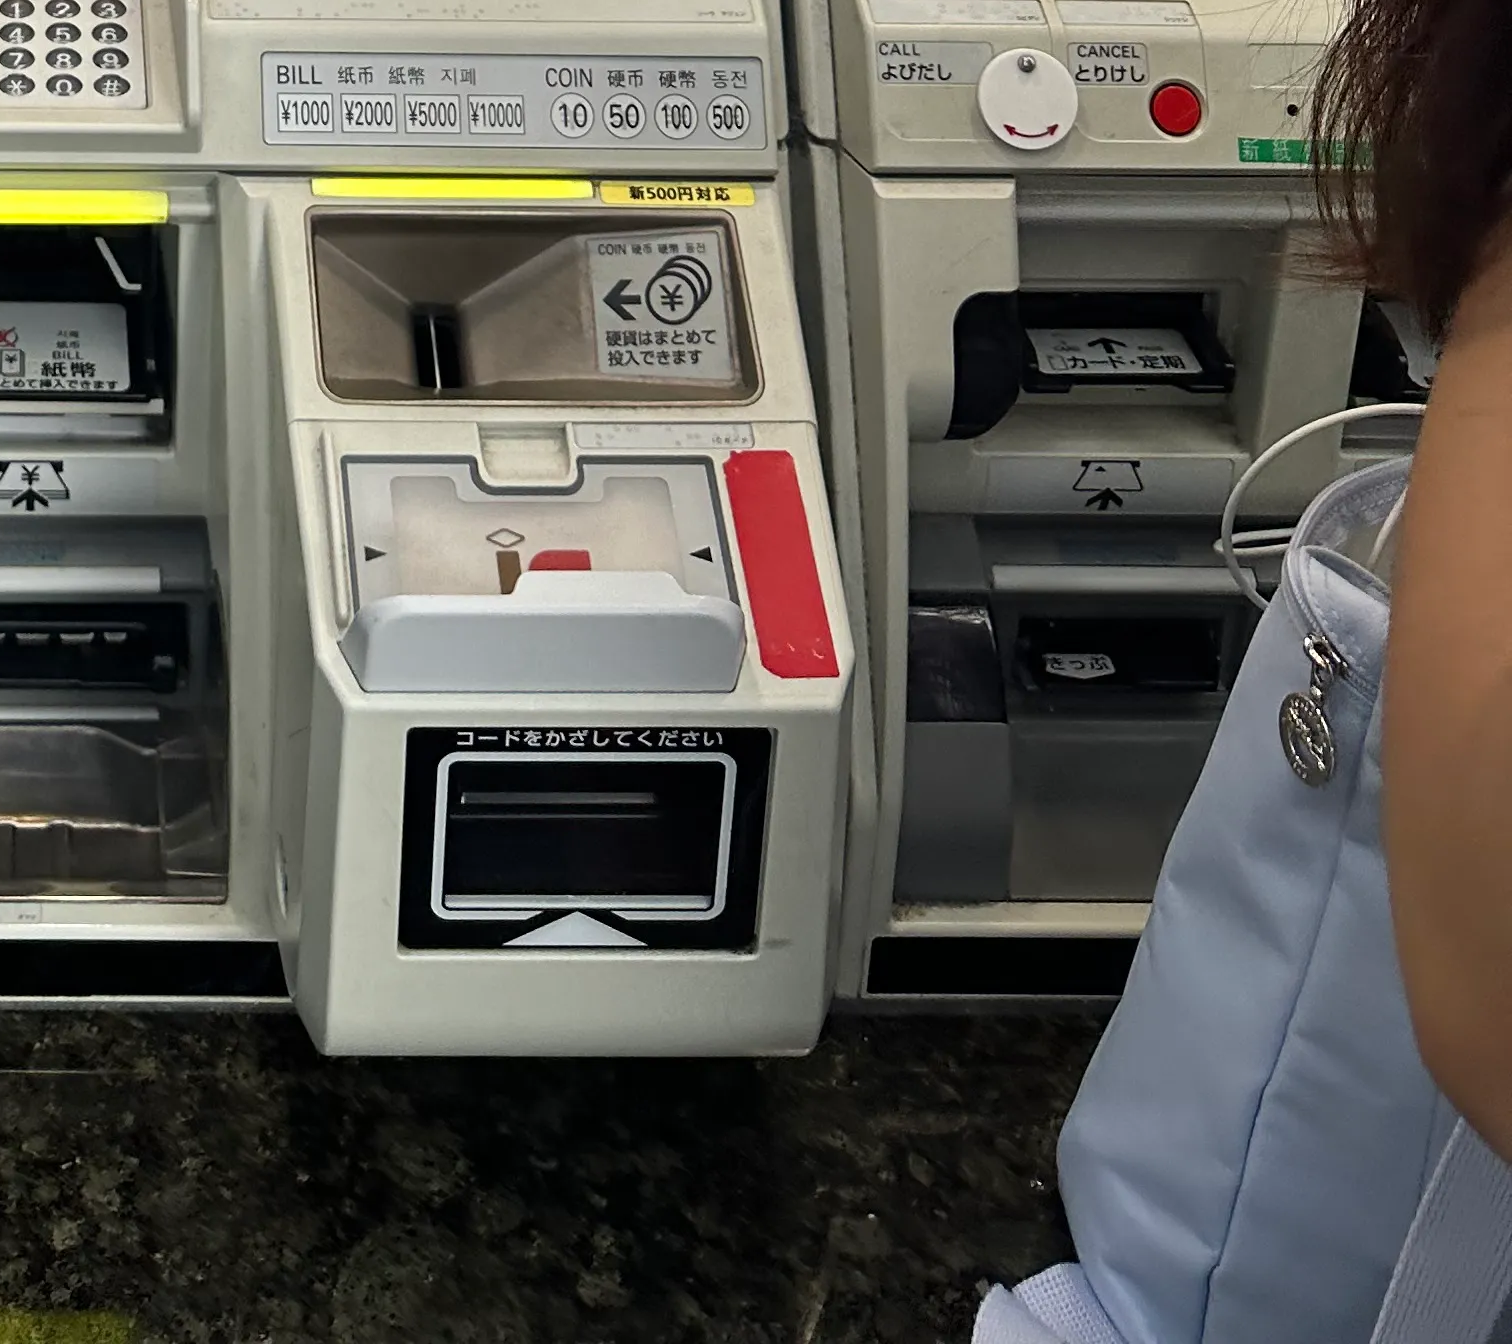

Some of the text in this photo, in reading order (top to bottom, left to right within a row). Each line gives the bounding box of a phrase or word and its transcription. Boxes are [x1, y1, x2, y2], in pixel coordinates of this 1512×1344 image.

[54, 27, 118, 43] 5 6
[878, 43, 921, 56] CALL
[1076, 44, 1141, 59] CANCEL
[9, 52, 120, 69] 7 8 9
[276, 65, 323, 85] BILL
[545, 67, 593, 88] COIN
[881, 63, 953, 82] よびだし
[1074, 64, 1146, 83] とりけし
[281, 98, 524, 130] ¥1000 ¥2000 ¥5000 ¥10000
[557, 103, 746, 131] 10 50 100 500
[628, 185, 731, 202] 新500円対応
[597, 243, 627, 256] COIN
[605, 329, 717, 347] 硬貨はまとめて
[607, 349, 702, 367] 投入できます
[456, 730, 725, 748] コードをかざしてください
